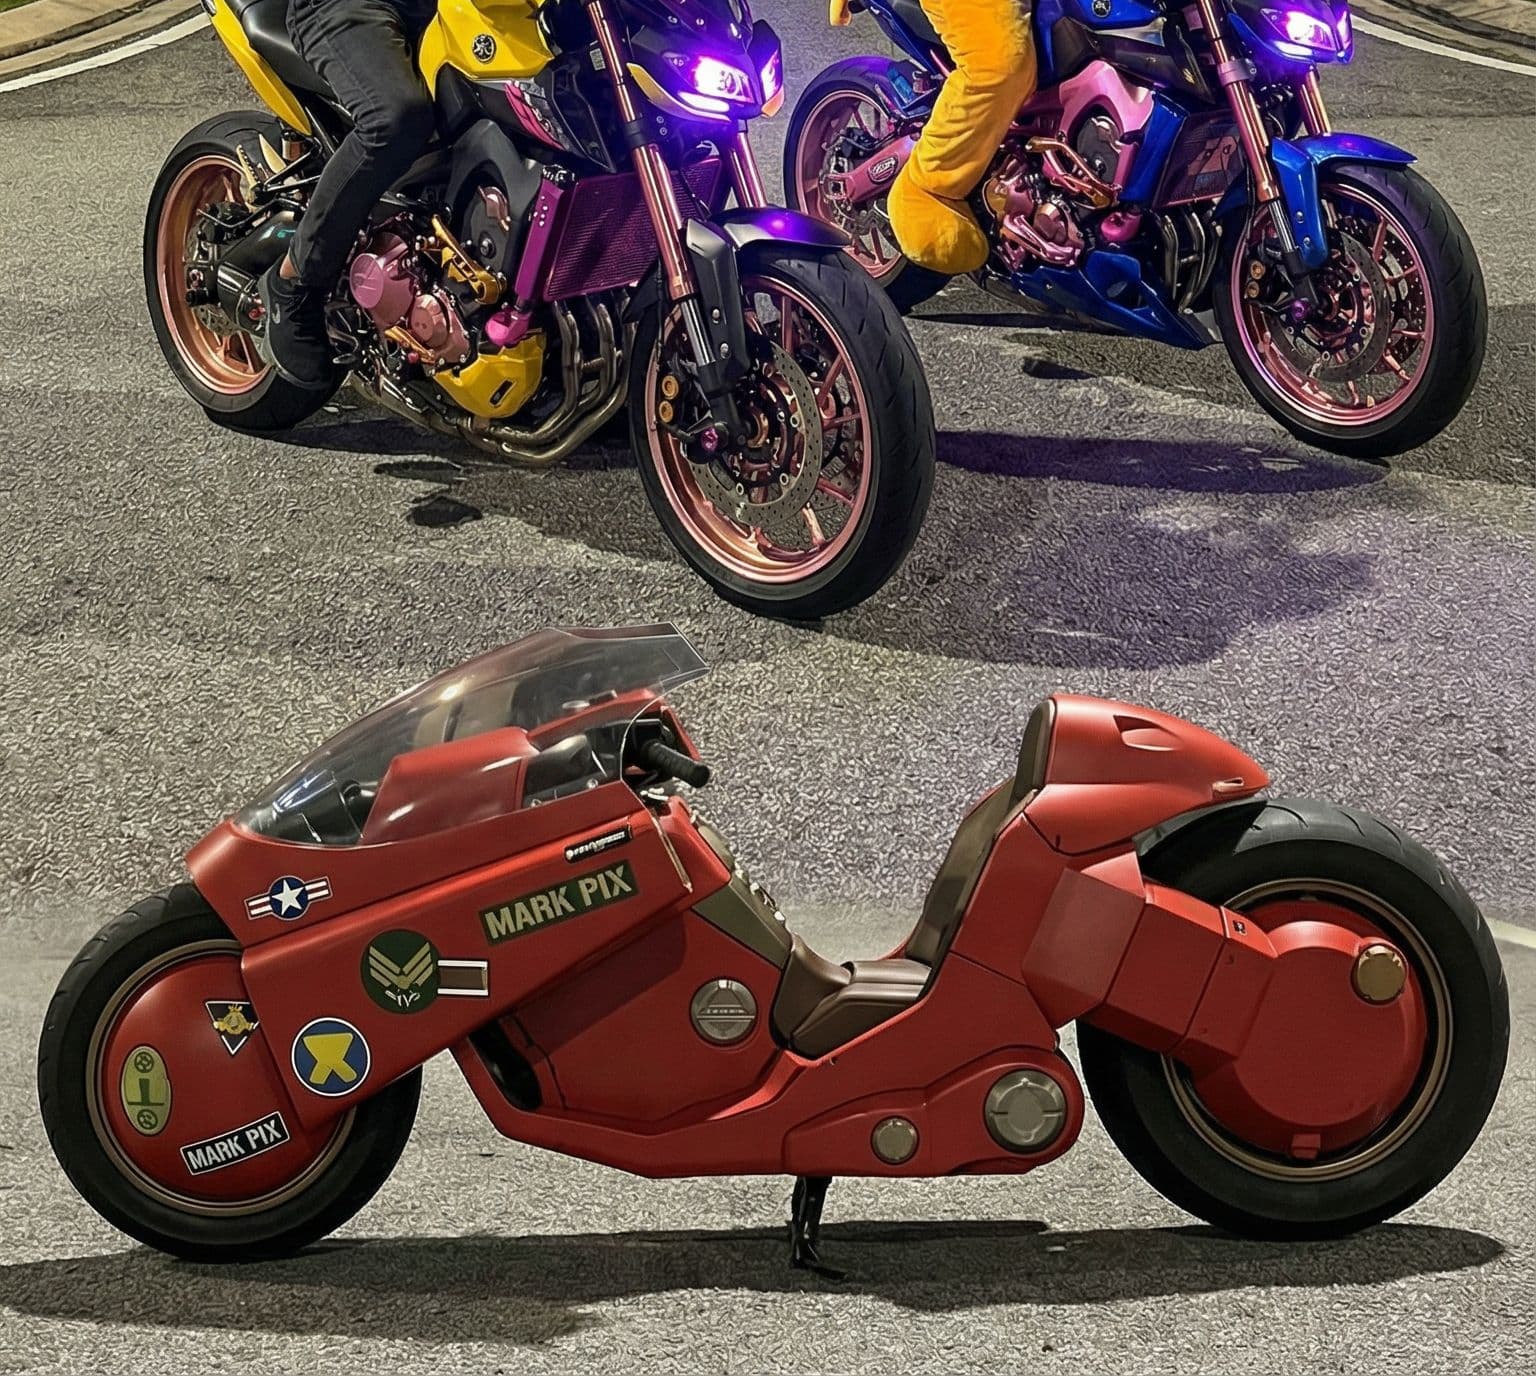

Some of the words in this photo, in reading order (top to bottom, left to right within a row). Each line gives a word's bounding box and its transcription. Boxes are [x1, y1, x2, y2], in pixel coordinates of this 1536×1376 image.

[484, 886, 575, 939] MARK
[578, 864, 632, 907] PIX
[186, 1135, 246, 1170] MARK
[245, 1119, 282, 1150] PIX
